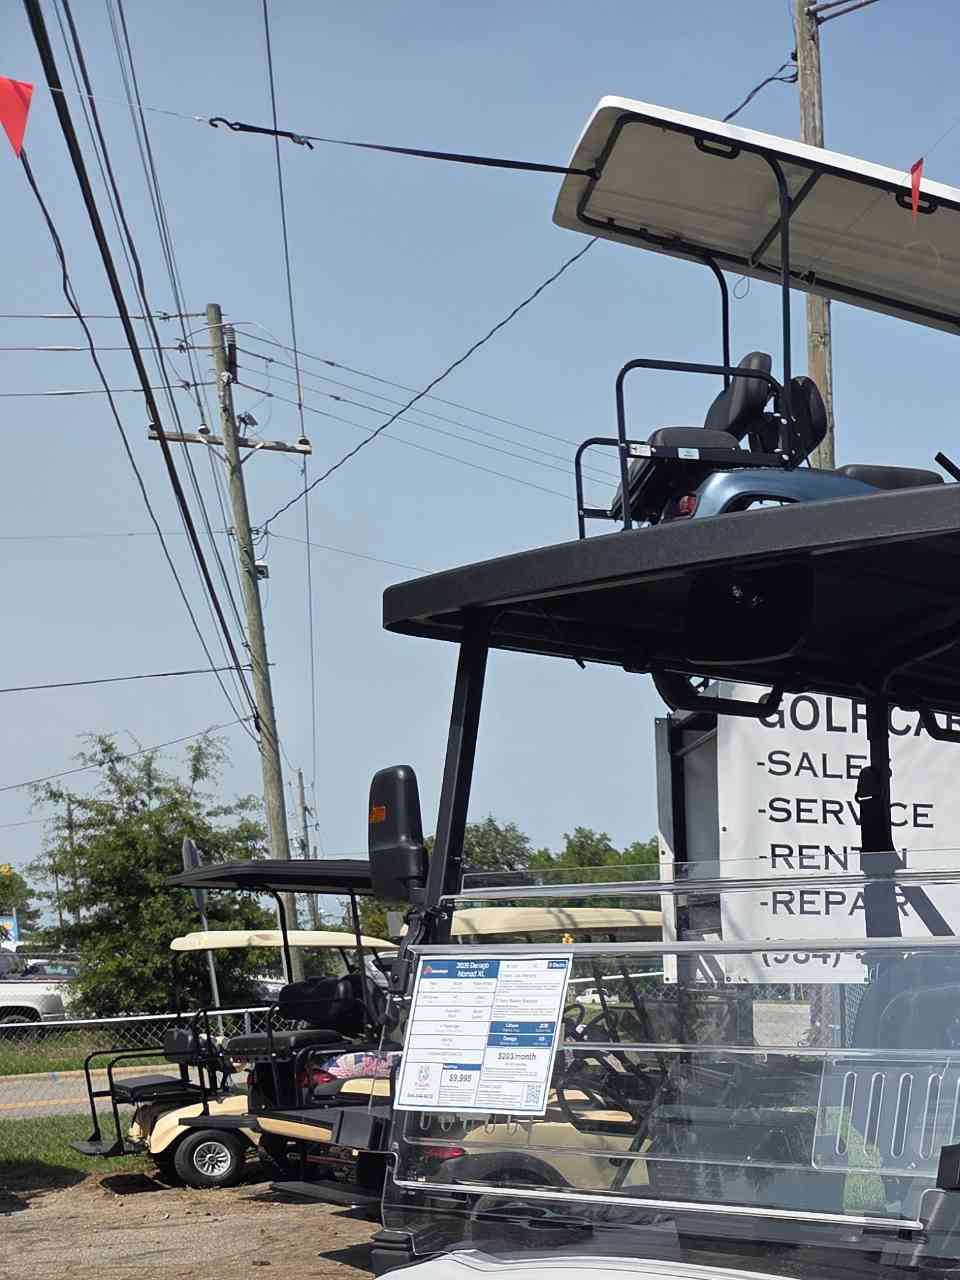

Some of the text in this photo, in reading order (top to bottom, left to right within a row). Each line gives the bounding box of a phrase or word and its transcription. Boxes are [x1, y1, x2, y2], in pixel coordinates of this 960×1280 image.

[756, 750, 892, 780] -SALE
[758, 797, 934, 828] -SERVCE
[760, 890, 910, 917] -REPAR
